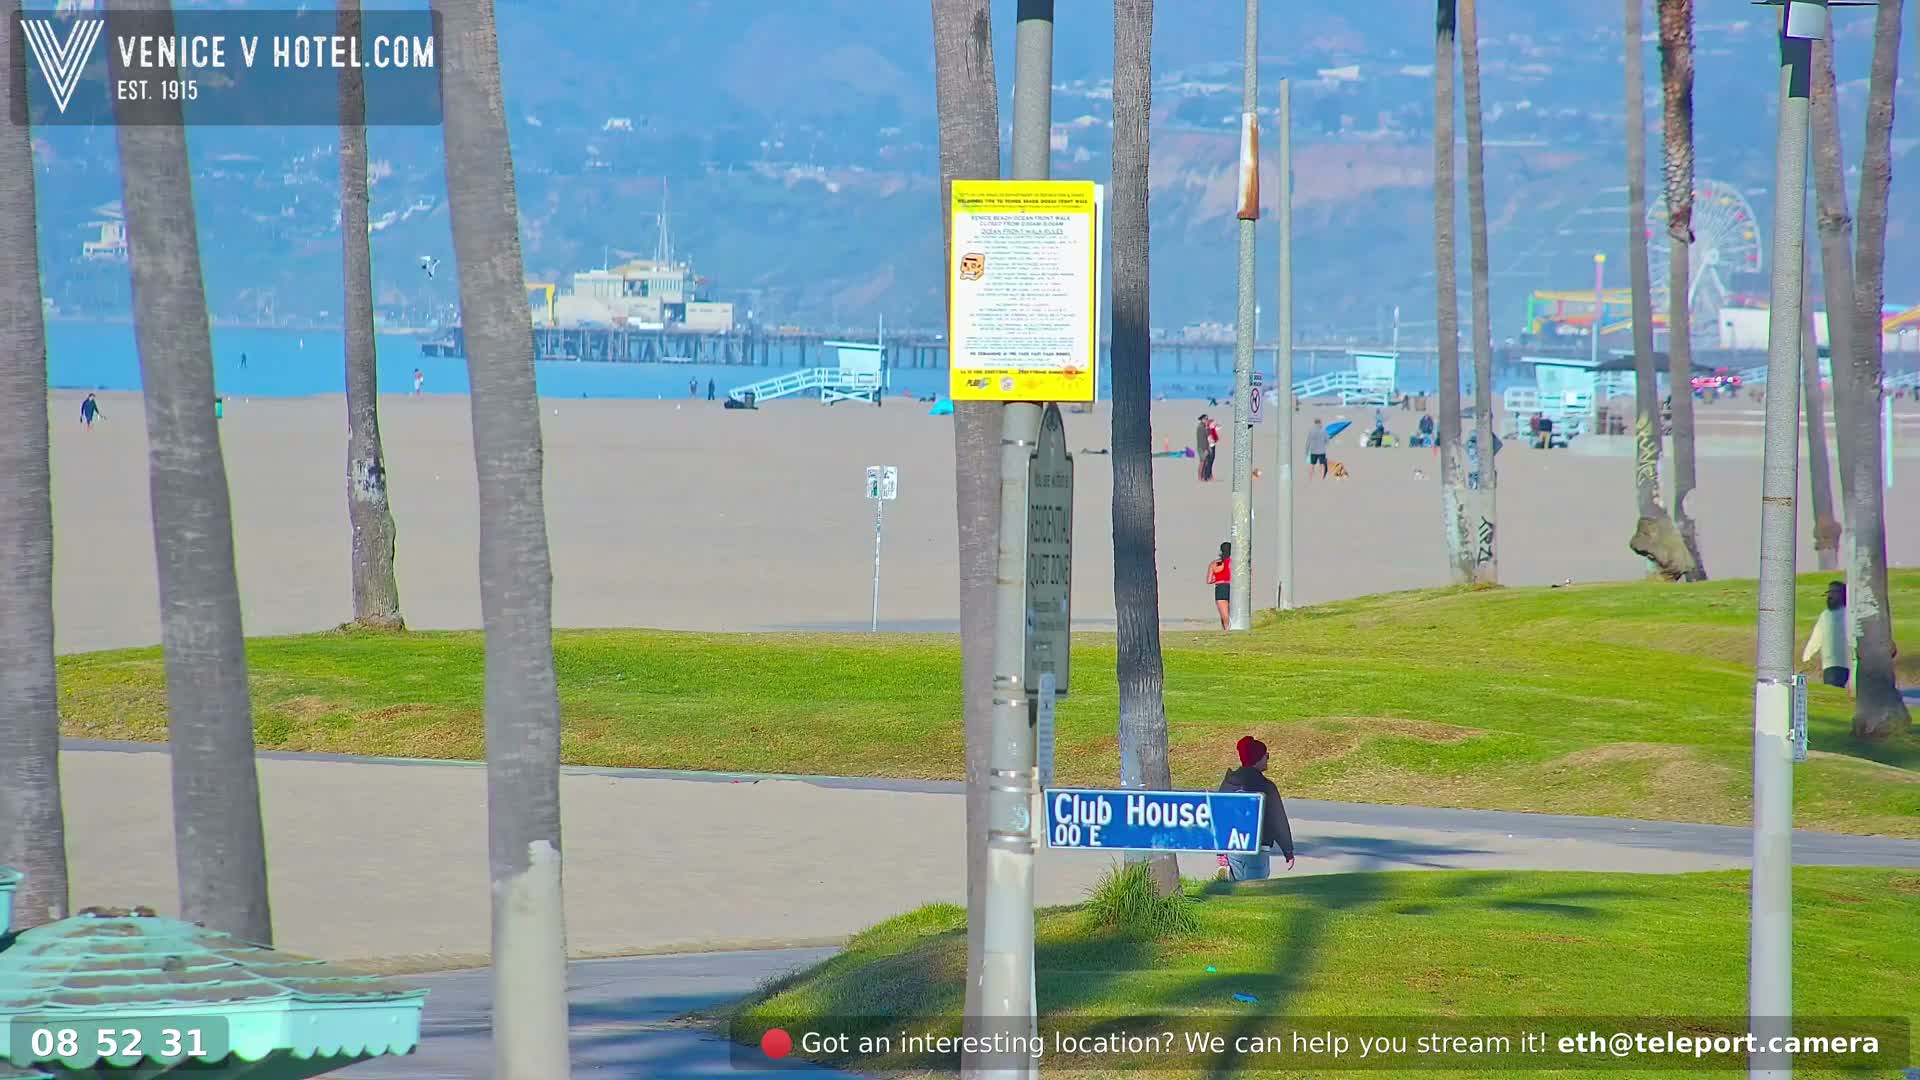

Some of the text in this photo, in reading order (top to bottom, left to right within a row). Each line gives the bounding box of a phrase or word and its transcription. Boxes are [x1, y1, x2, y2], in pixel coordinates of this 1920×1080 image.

[1054, 793, 1211, 827] Club House
[1055, 824, 1249, 850] 00 E Av
